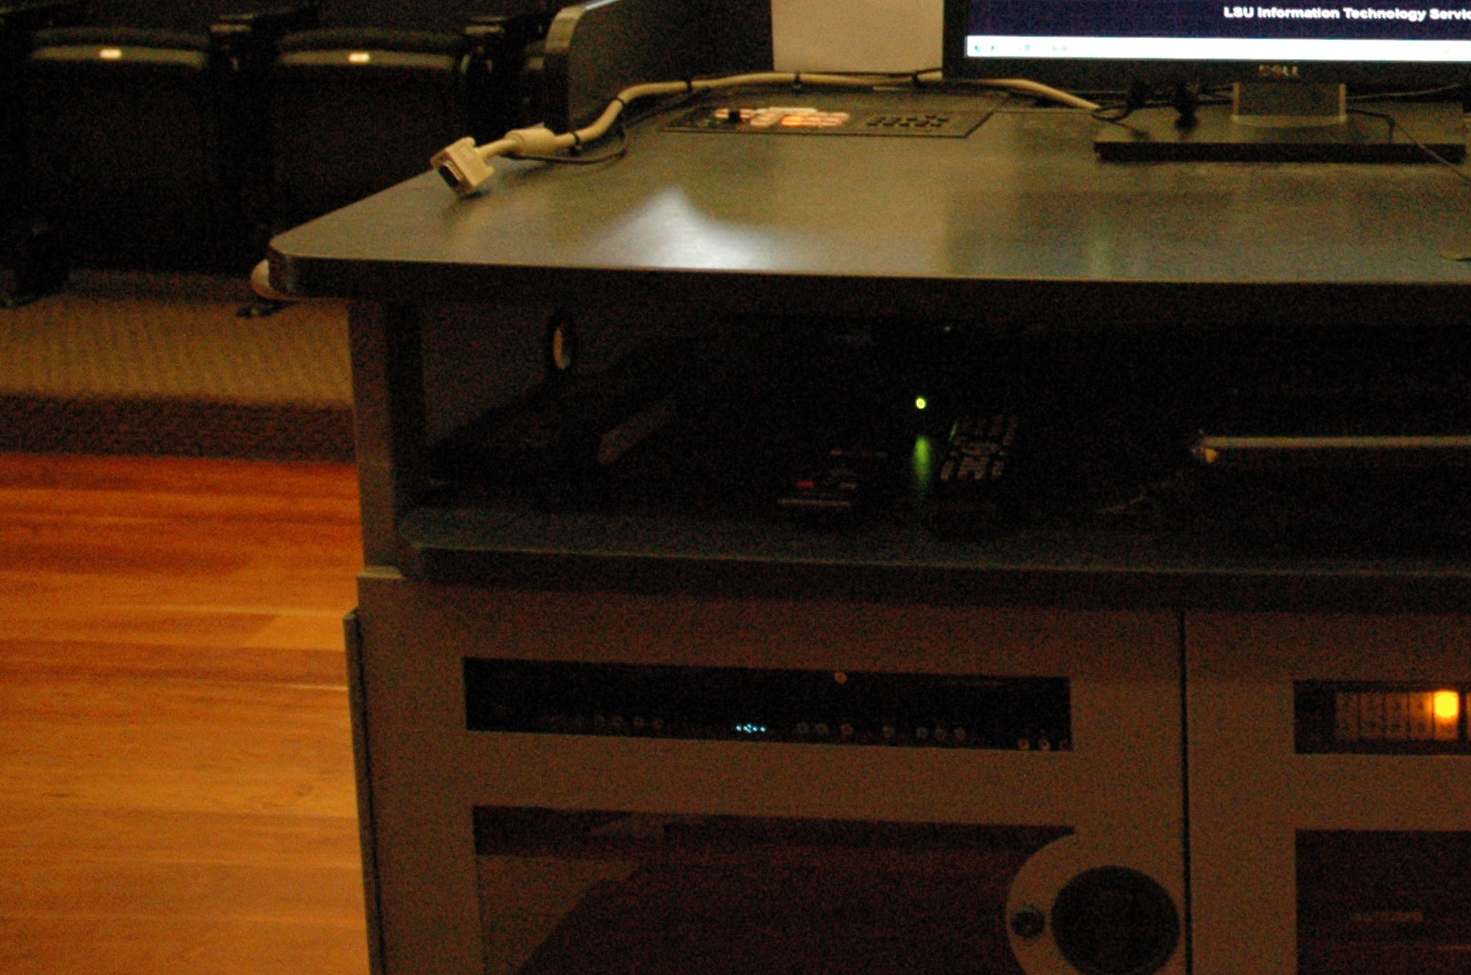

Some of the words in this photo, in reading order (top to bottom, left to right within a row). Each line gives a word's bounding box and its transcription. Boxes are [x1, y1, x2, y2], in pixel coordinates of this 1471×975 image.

[1223, 6, 1255, 18] LSU
[1256, 6, 1341, 20] Information
[1342, 7, 1427, 23] Technology
